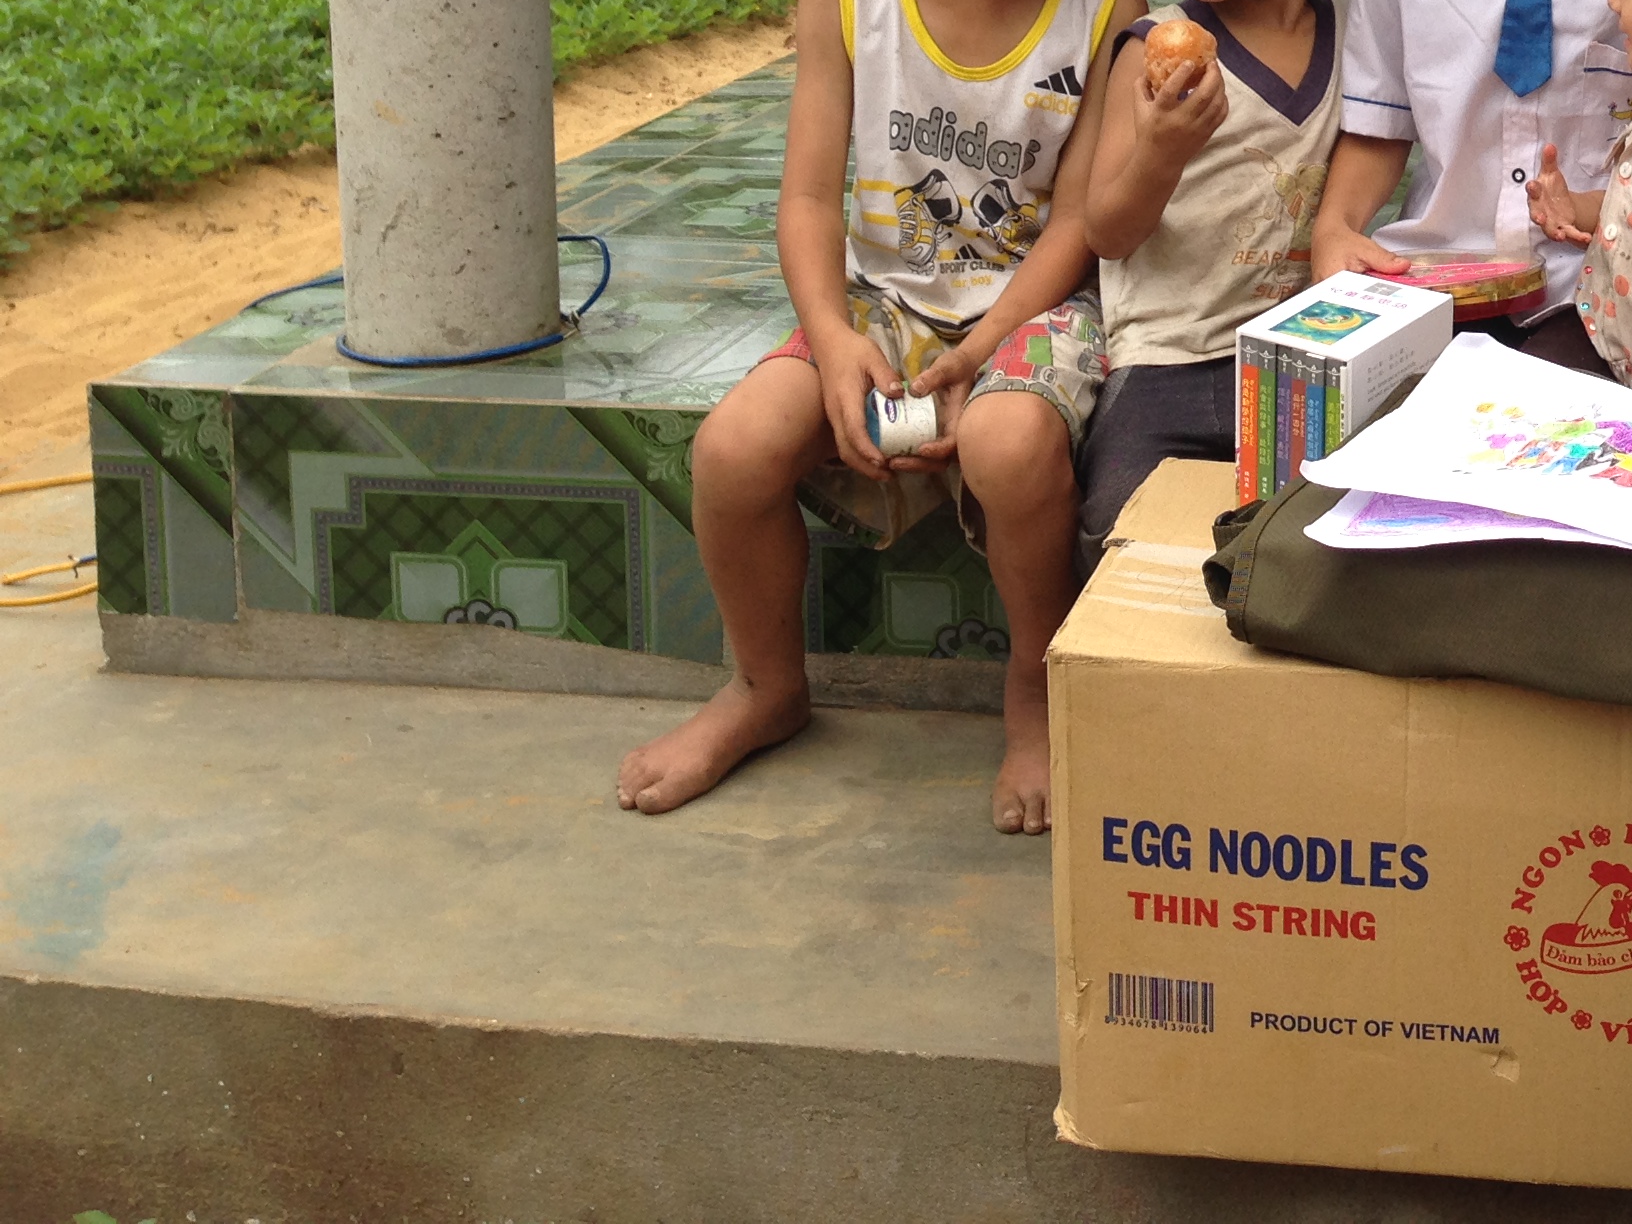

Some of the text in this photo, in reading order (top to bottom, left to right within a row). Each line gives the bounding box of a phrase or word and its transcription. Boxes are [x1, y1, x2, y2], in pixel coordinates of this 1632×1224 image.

[940, 260, 1006, 274] SPORT CLUB
[1231, 250, 1283, 265] BEAR
[1102, 816, 1429, 891] EGG NOODLES
[1511, 830, 1586, 914] NGON
[1128, 891, 1377, 941] THIN STRING
[1250, 1011, 1501, 1045] PRODUCT OF VIETNAM
